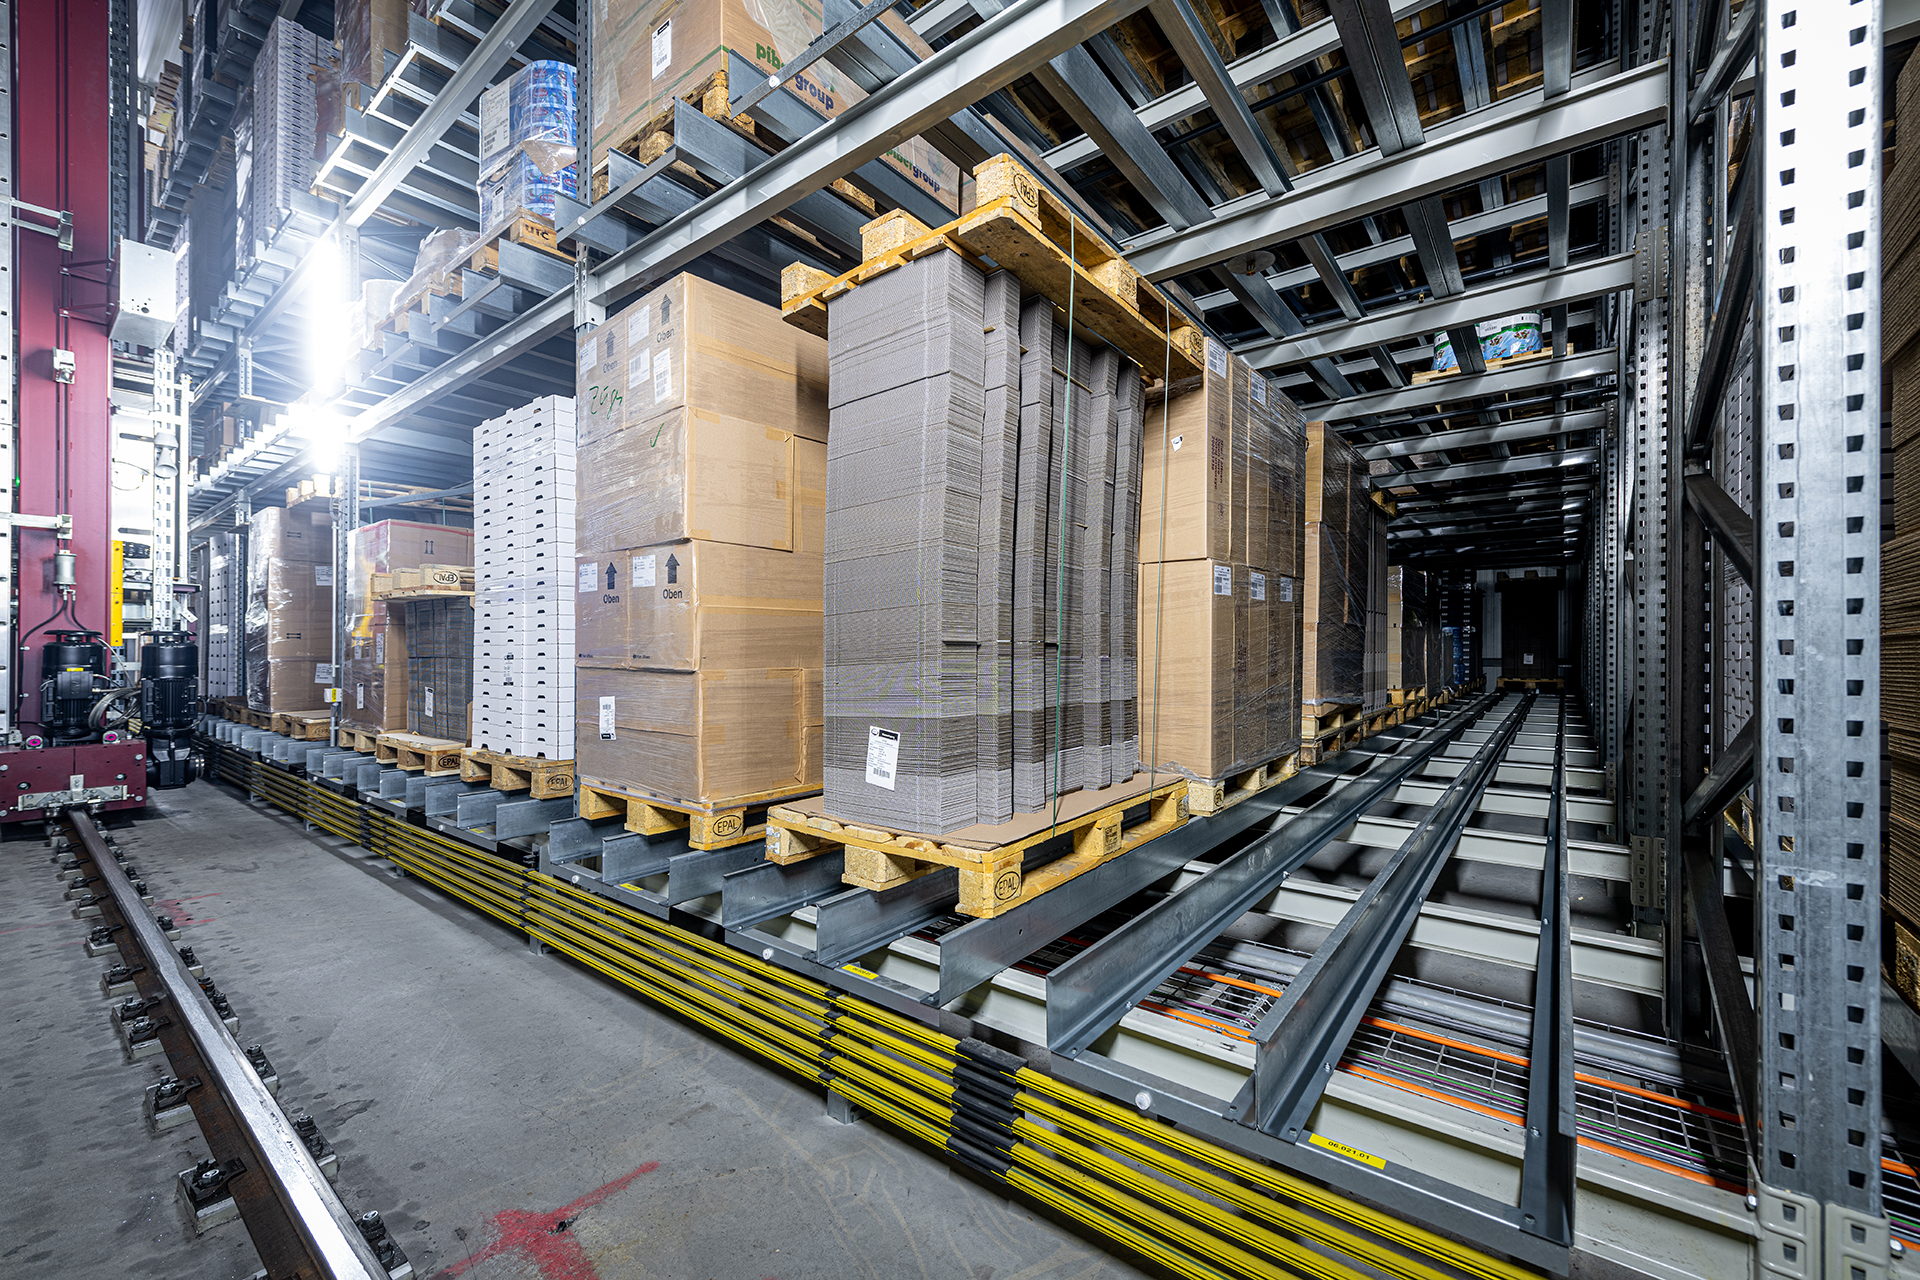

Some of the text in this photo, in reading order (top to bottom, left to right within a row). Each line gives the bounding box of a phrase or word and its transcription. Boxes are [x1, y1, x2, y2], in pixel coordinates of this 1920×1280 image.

[657, 328, 674, 343] Oben
[602, 594, 620, 604] Oben
[662, 588, 683, 599] Oben
[717, 819, 738, 833] EPAL
[998, 876, 1017, 896] EPAL
[1327, 1140, 1370, 1160] 06.021.01
